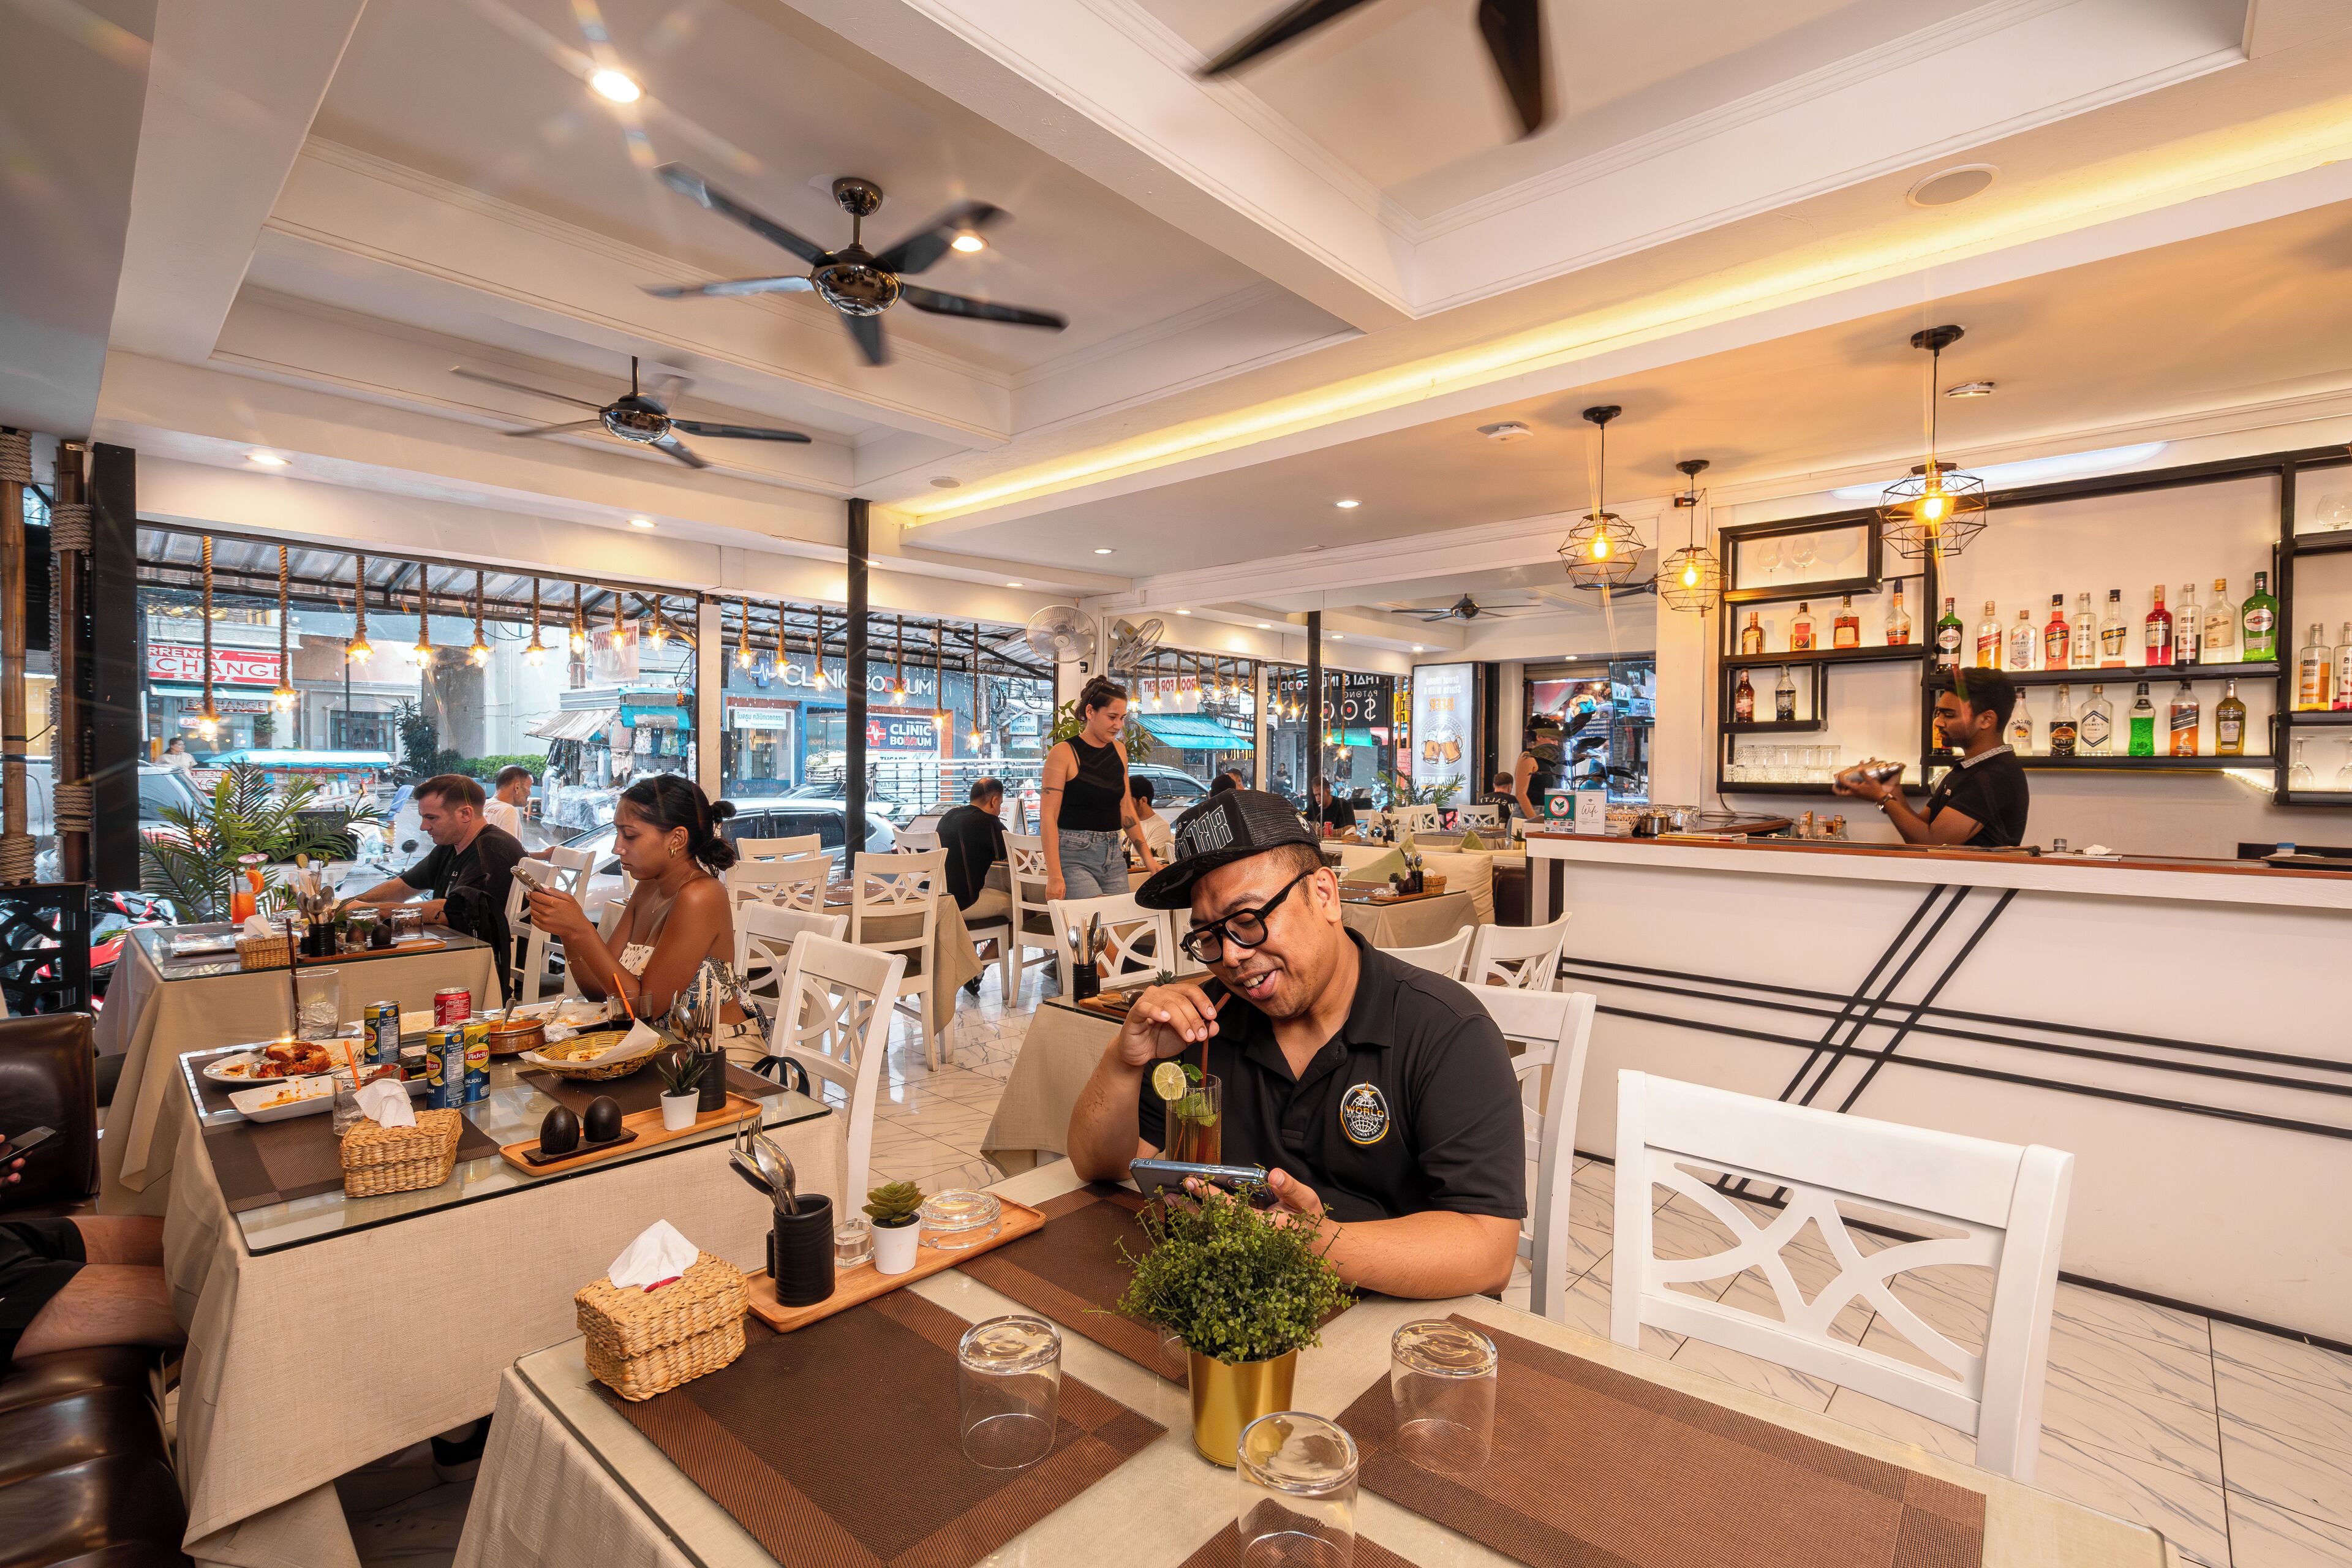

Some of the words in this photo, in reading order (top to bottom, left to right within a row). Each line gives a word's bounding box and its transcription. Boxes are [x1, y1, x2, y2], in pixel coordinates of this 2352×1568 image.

[187, 699, 264, 709] EXHANGE
[890, 724, 932, 736] CLINIC
[890, 736, 932, 747] BODRUM
[1346, 1105, 1384, 1118] WORLD
